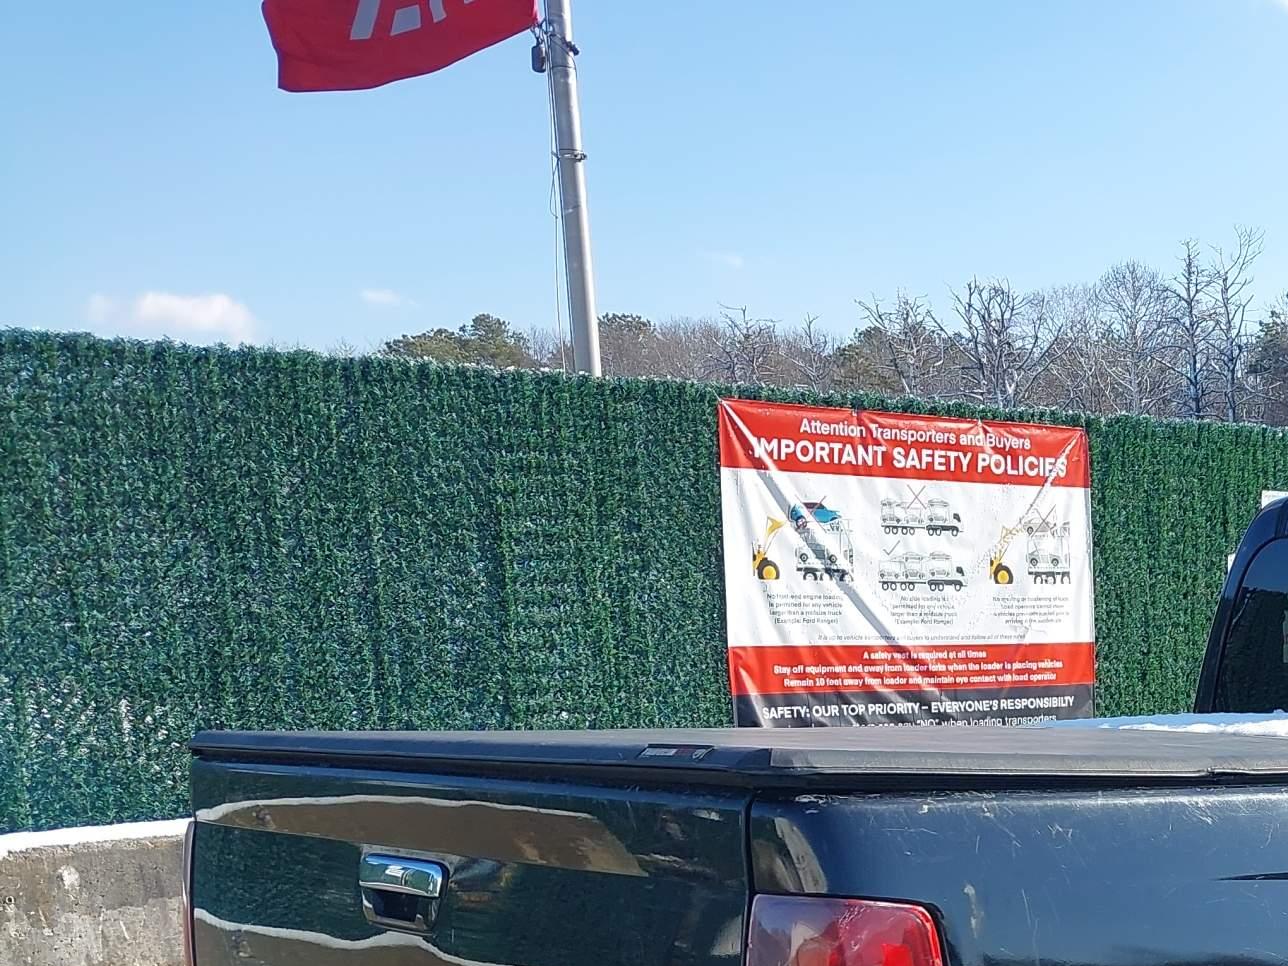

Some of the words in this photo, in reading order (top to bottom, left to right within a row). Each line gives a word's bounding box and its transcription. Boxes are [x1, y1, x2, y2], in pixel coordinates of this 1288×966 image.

[800, 418, 866, 438] Attention
[870, 424, 956, 445] Transporters
[960, 433, 984, 447] and
[986, 434, 1031, 451] Buyers
[752, 436, 887, 467] IMPORTANT
[893, 446, 972, 473] SAFETY
[977, 452, 1068, 478] POLICIES
[863, 650, 869, 660] A
[870, 650, 892, 661] safety
[893, 651, 909, 660] vest
[918, 650, 948, 661] required
[967, 649, 987, 659] times
[774, 665, 791, 675] Stay
[792, 664, 804, 674] off
[805, 664, 847, 674] equipment
[847, 664, 863, 673] and
[864, 665, 884, 674] away
[885, 664, 902, 673] from
[903, 663, 928, 672] loader
[947, 662, 967, 673] when
[968, 662, 979, 671] the
[980, 662, 1003, 671] loader
[1012, 660, 1037, 671] placing
[1038, 659, 1063, 669] vehicles
[784, 678, 814, 687] Remain
[815, 678, 825, 687] 10
[843, 678, 864, 687] away
[864, 677, 882, 686] from
[883, 676, 907, 686] loader
[923, 675, 955, 685] maintain
[969, 674, 996, 684] contact
[997, 673, 1012, 682] with
[1012, 673, 1029, 682] load
[1029, 672, 1056, 682] operator
[762, 705, 811, 720] SAFETY:
[812, 704, 839, 718] OUR
[841, 703, 866, 717] TOP
[868, 701, 920, 716] PRIORITY
[931, 699, 999, 714] EVERYONE'S
